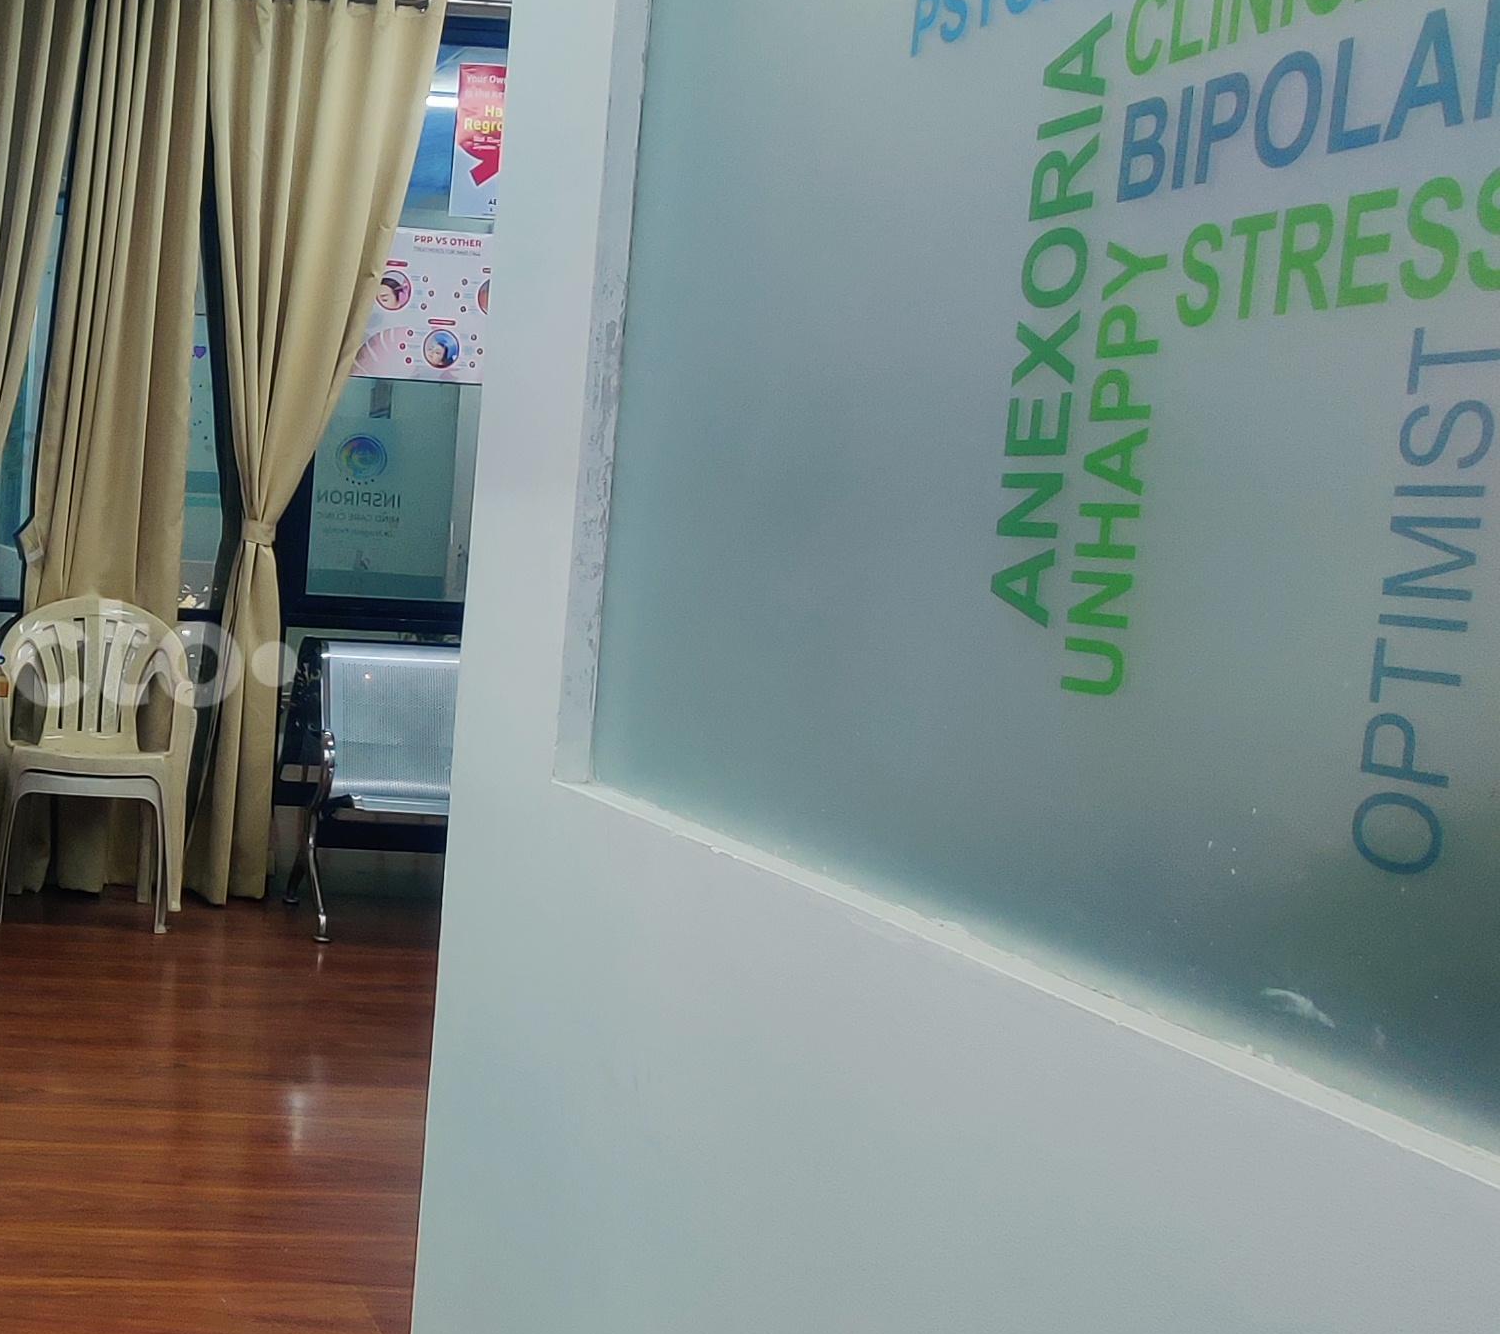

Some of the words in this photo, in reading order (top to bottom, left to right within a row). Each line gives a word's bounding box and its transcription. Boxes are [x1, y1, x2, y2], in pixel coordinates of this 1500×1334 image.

[414, 235, 433, 244] PRP
[436, 236, 447, 245] VS
[449, 237, 482, 248] OTHER
[990, 12, 1114, 629] ANEXORIA
[1059, 240, 1168, 697] UNHAPPY
[1351, 327, 1500, 877] OPTIMIST
